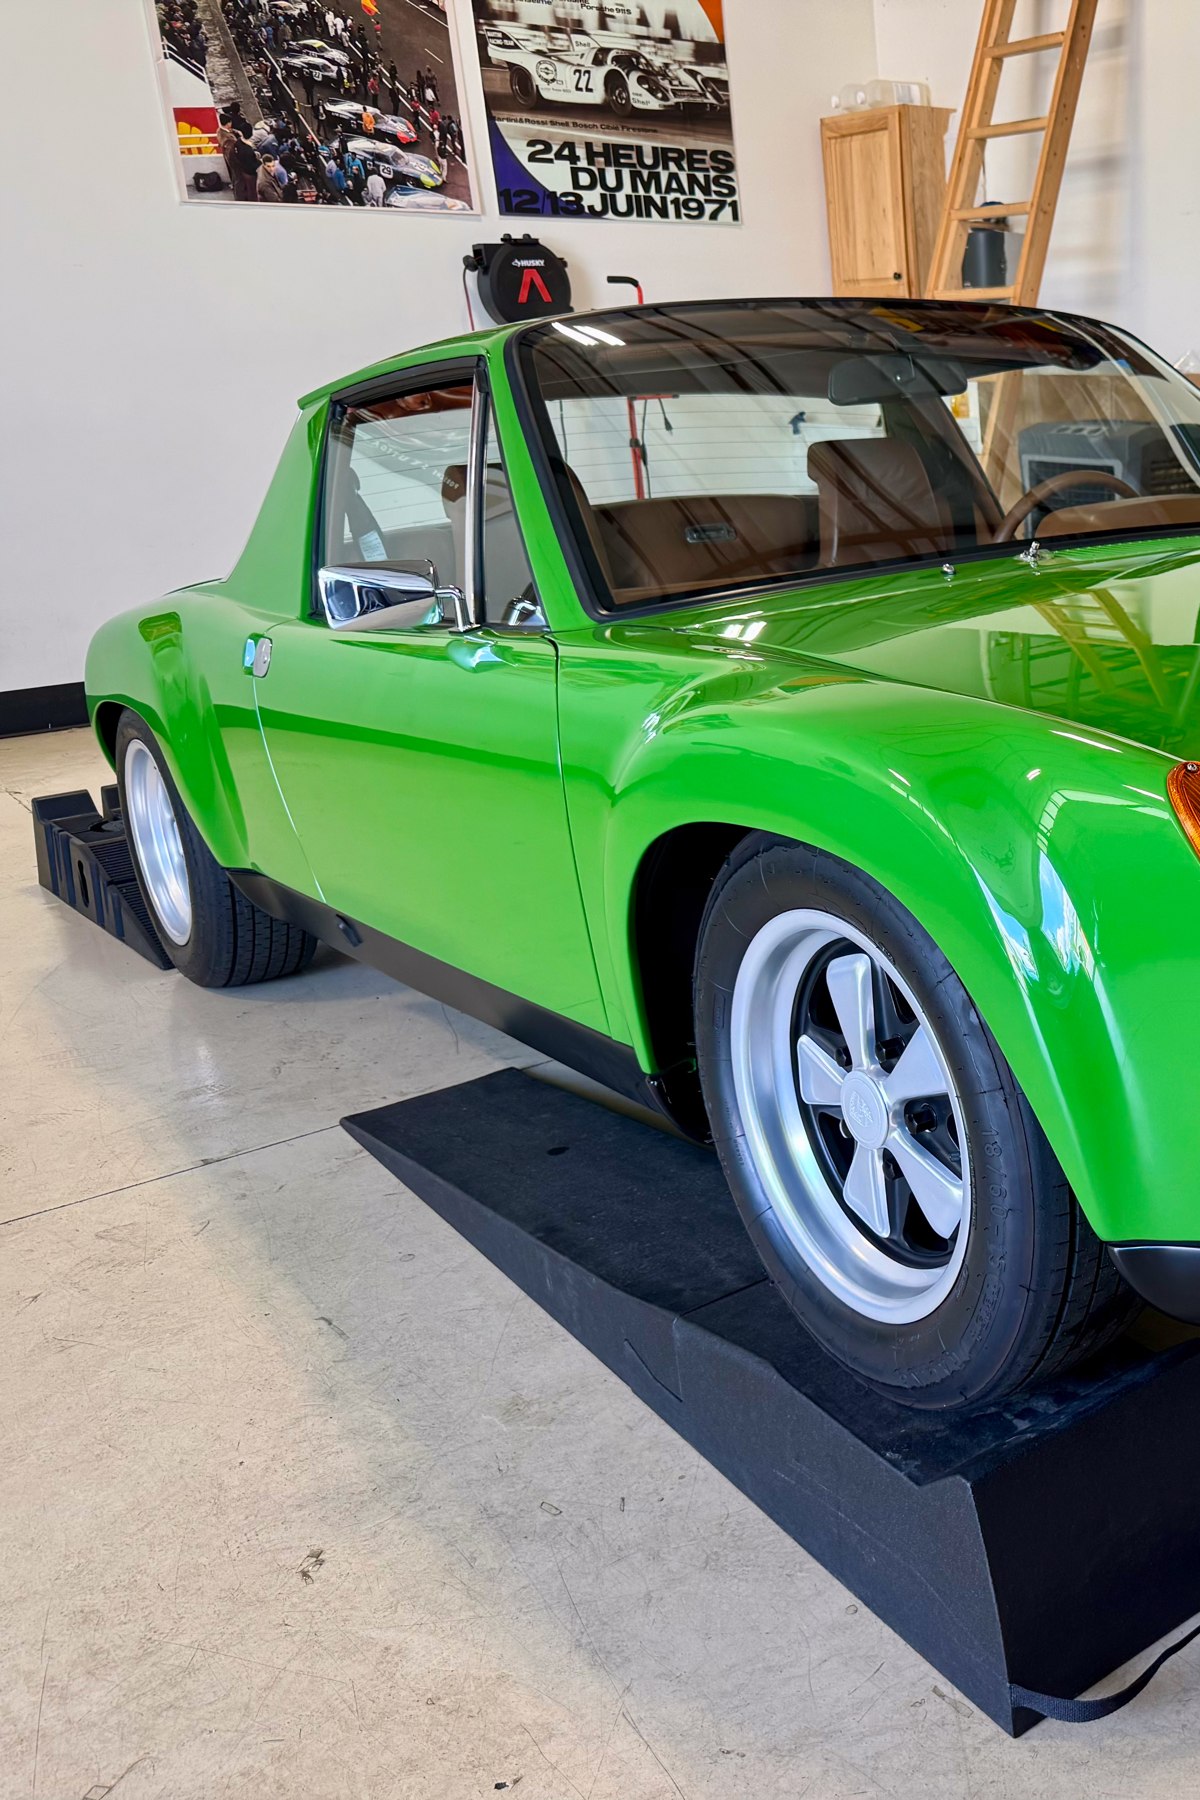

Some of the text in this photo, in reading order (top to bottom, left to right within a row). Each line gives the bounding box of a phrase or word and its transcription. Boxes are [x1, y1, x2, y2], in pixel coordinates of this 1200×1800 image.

[580, 3, 615, 12] Porsche
[575, 40, 591, 48] Shell
[573, 68, 594, 93] 22
[572, 121, 599, 130] Bosch
[526, 139, 736, 175] 24 HEURES
[570, 166, 738, 198] DU MANS
[587, 192, 670, 220] JUIN
[670, 196, 740, 222] 1971
[520, 259, 545, 267] HUSKY
